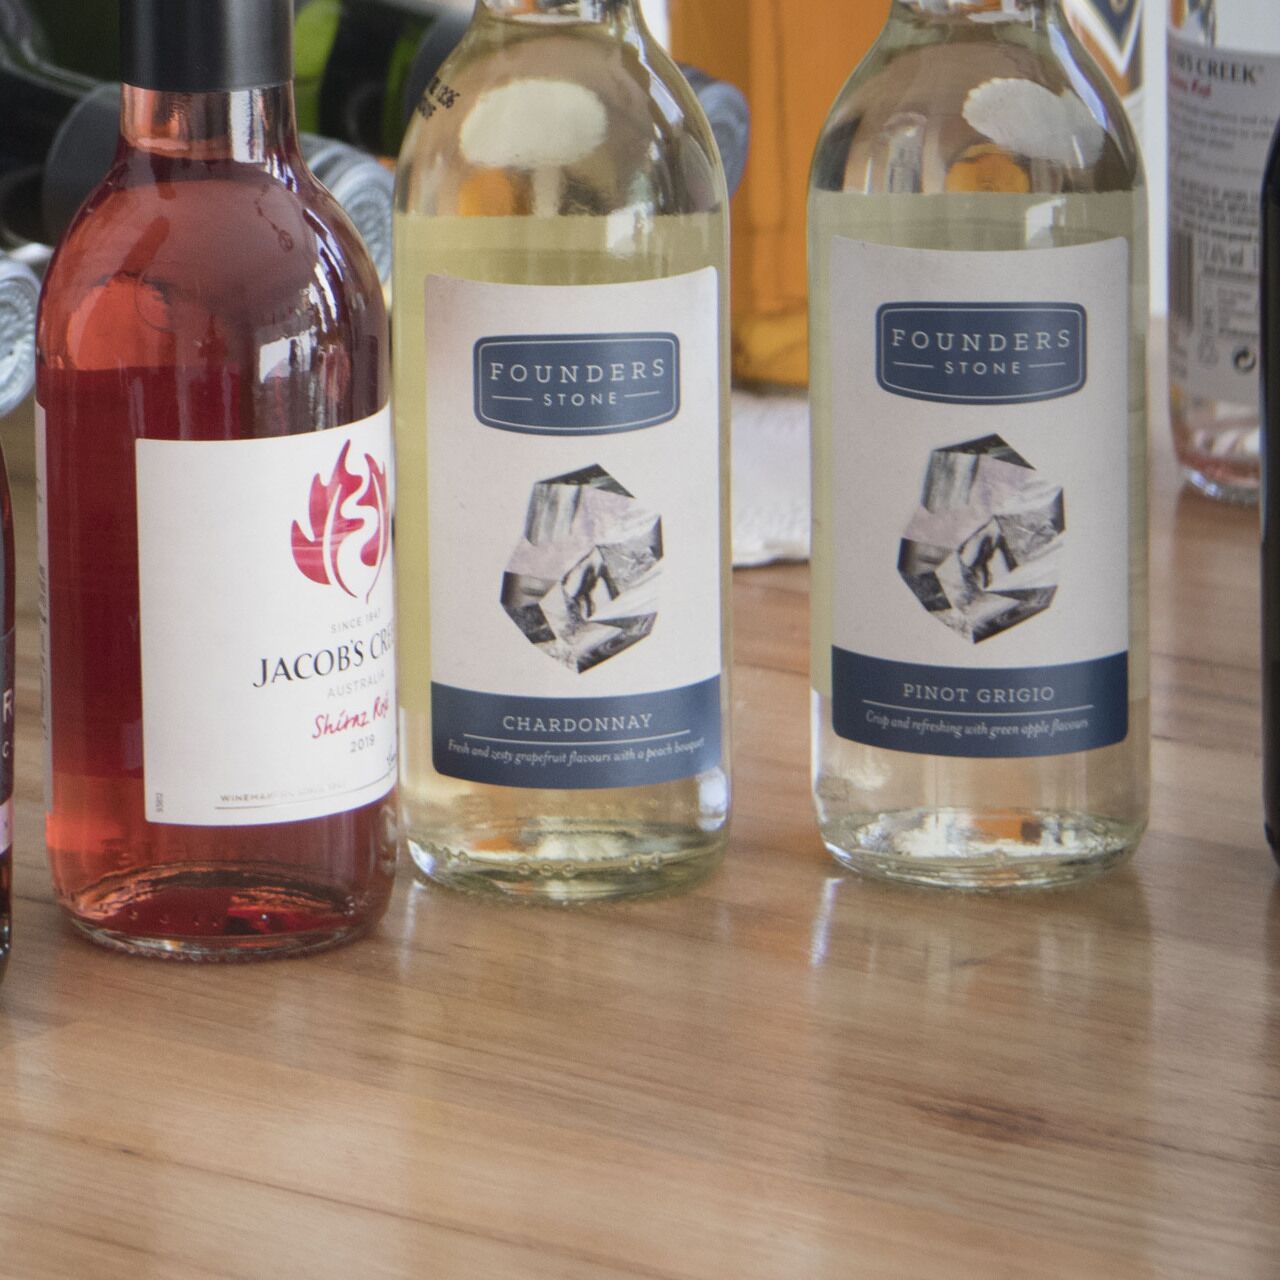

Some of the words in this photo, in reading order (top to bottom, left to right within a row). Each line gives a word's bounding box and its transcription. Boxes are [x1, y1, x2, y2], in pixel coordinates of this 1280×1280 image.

[890, 327, 1072, 354] FOUNDERS
[489, 357, 667, 385] FOUNDERS
[943, 359, 1022, 377] STONE
[542, 390, 619, 408] STONE
[252, 638, 365, 689] JACOB'S
[902, 683, 969, 703] PINOT
[975, 686, 1055, 704] GRIGIO
[502, 713, 654, 733] CHARDONNAY
[865, 709, 890, 730] Crisp
[890, 716, 910, 730] and
[911, 718, 963, 738] refreshing
[964, 721, 989, 736] with
[989, 724, 1020, 739] green
[1020, 722, 1049, 739] apple
[447, 738, 471, 754] Fresh
[471, 745, 490, 759] and
[490, 748, 514, 765] zesty
[514, 748, 567, 767] grapefruit
[567, 749, 612, 768] flavours
[612, 747, 637, 761] with
[645, 742, 673, 763] peach
